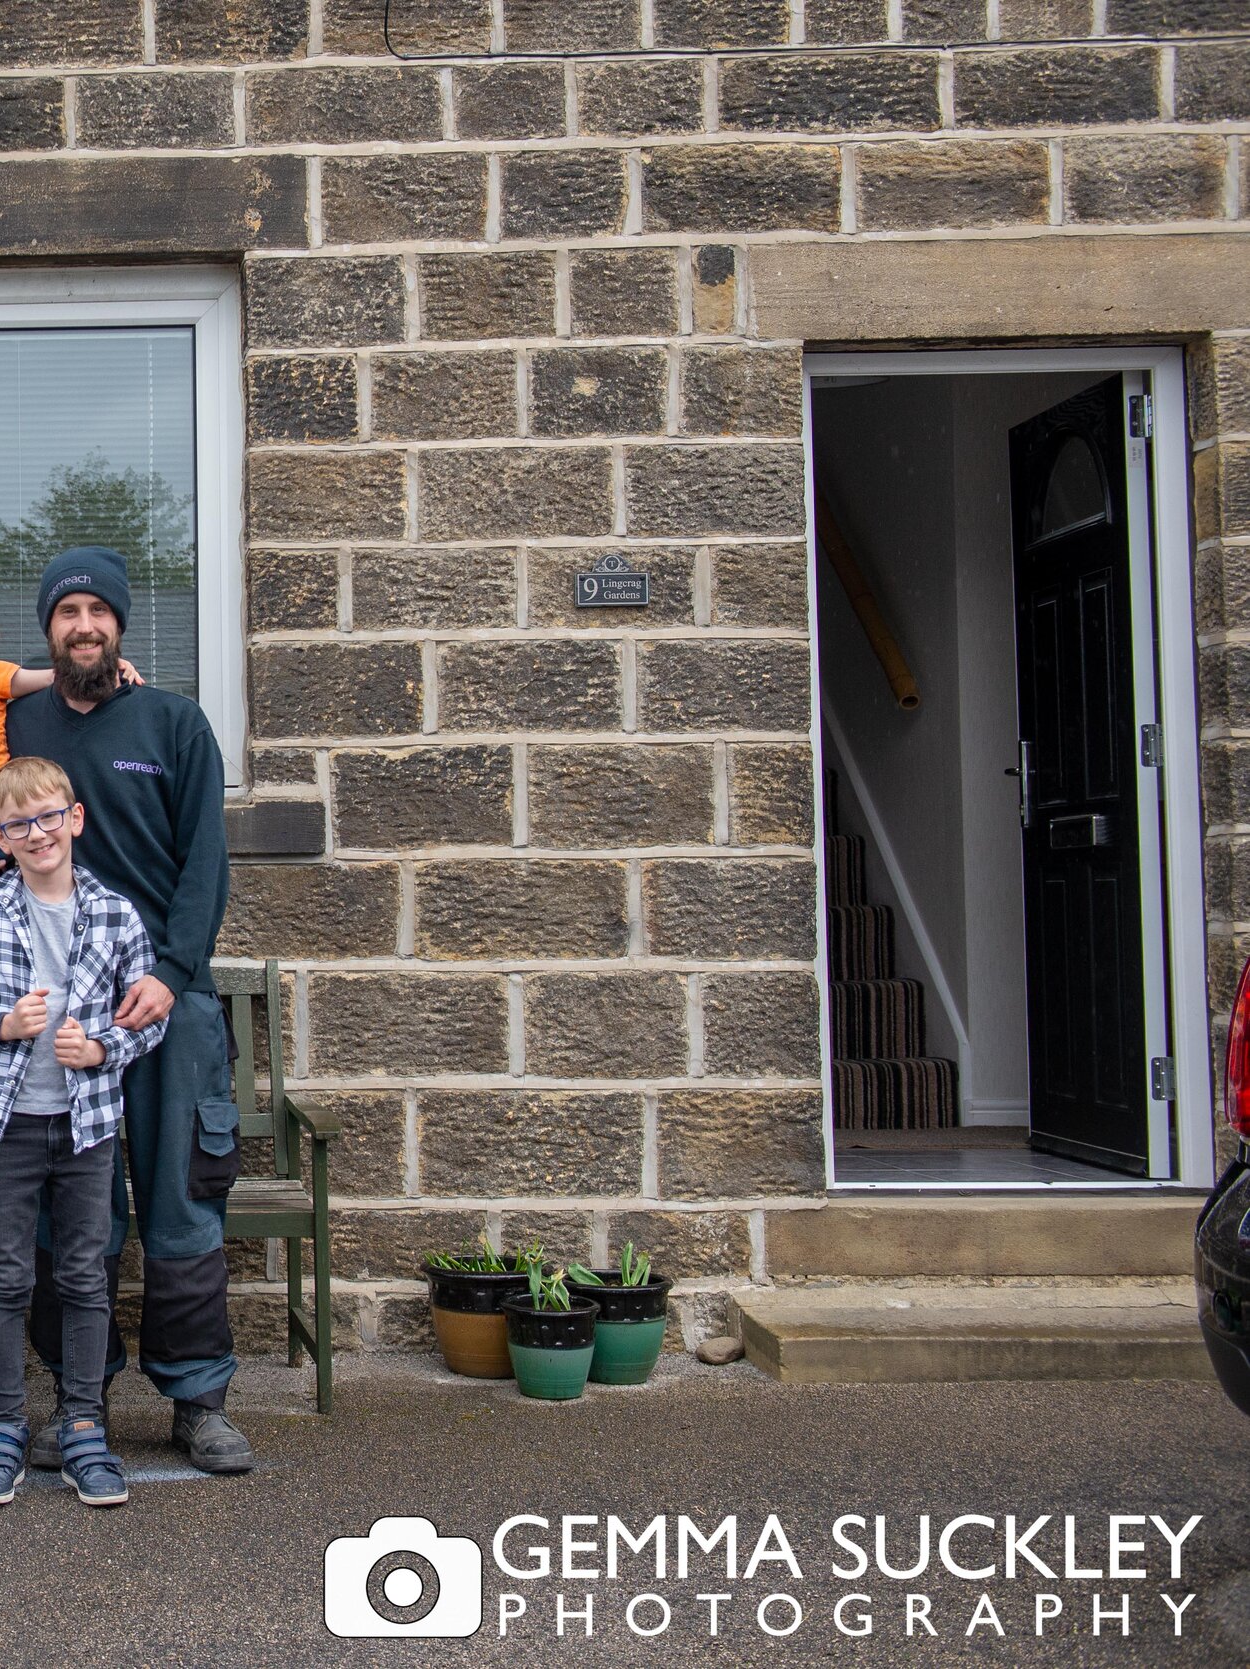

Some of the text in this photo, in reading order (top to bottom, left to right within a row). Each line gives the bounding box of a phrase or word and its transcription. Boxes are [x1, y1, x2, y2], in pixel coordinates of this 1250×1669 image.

[608, 560, 616, 568] T
[46, 574, 92, 604] openreach
[583, 577, 599, 602] 9
[602, 578, 642, 590] Lingcrag
[603, 590, 641, 600] Gardens
[113, 760, 162, 776] openreach
